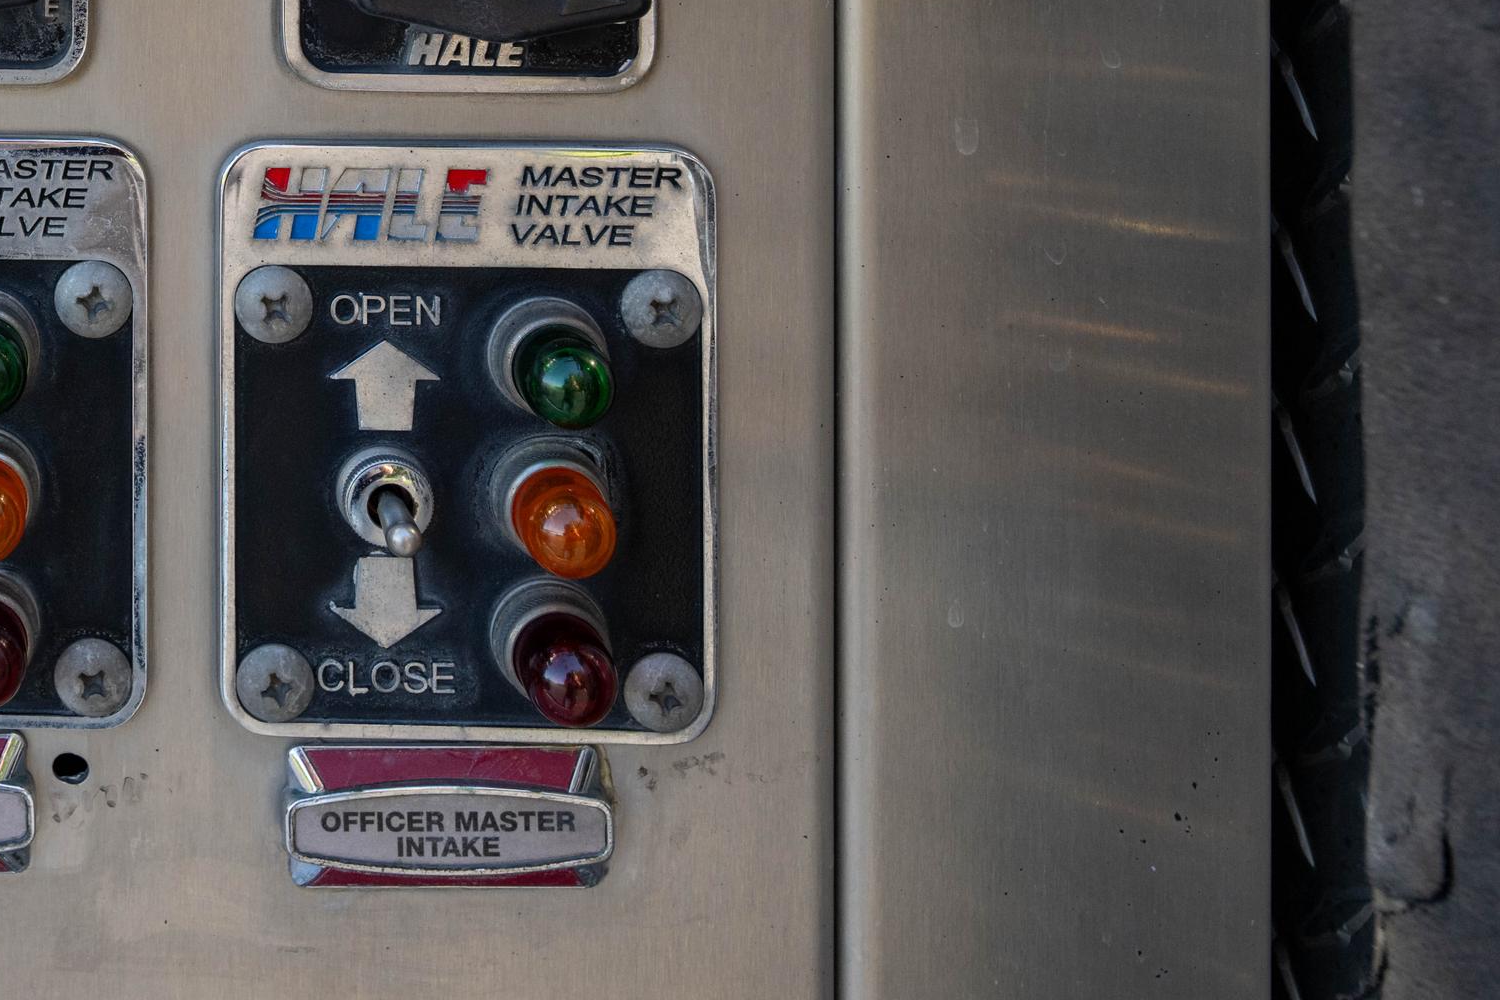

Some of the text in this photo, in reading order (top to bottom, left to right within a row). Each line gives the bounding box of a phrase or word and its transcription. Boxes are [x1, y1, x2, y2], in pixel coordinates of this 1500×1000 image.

[408, 33, 524, 67] HALE
[520, 165, 683, 189] MASTER
[253, 167, 490, 241] HALE
[515, 194, 656, 218] INTAKE
[510, 223, 634, 247] VALVE
[329, 293, 442, 327] OPEN
[316, 659, 456, 695] CLOSE
[320, 810, 576, 834] OFFICER MASTER
[396, 837, 500, 858] INTAKE
